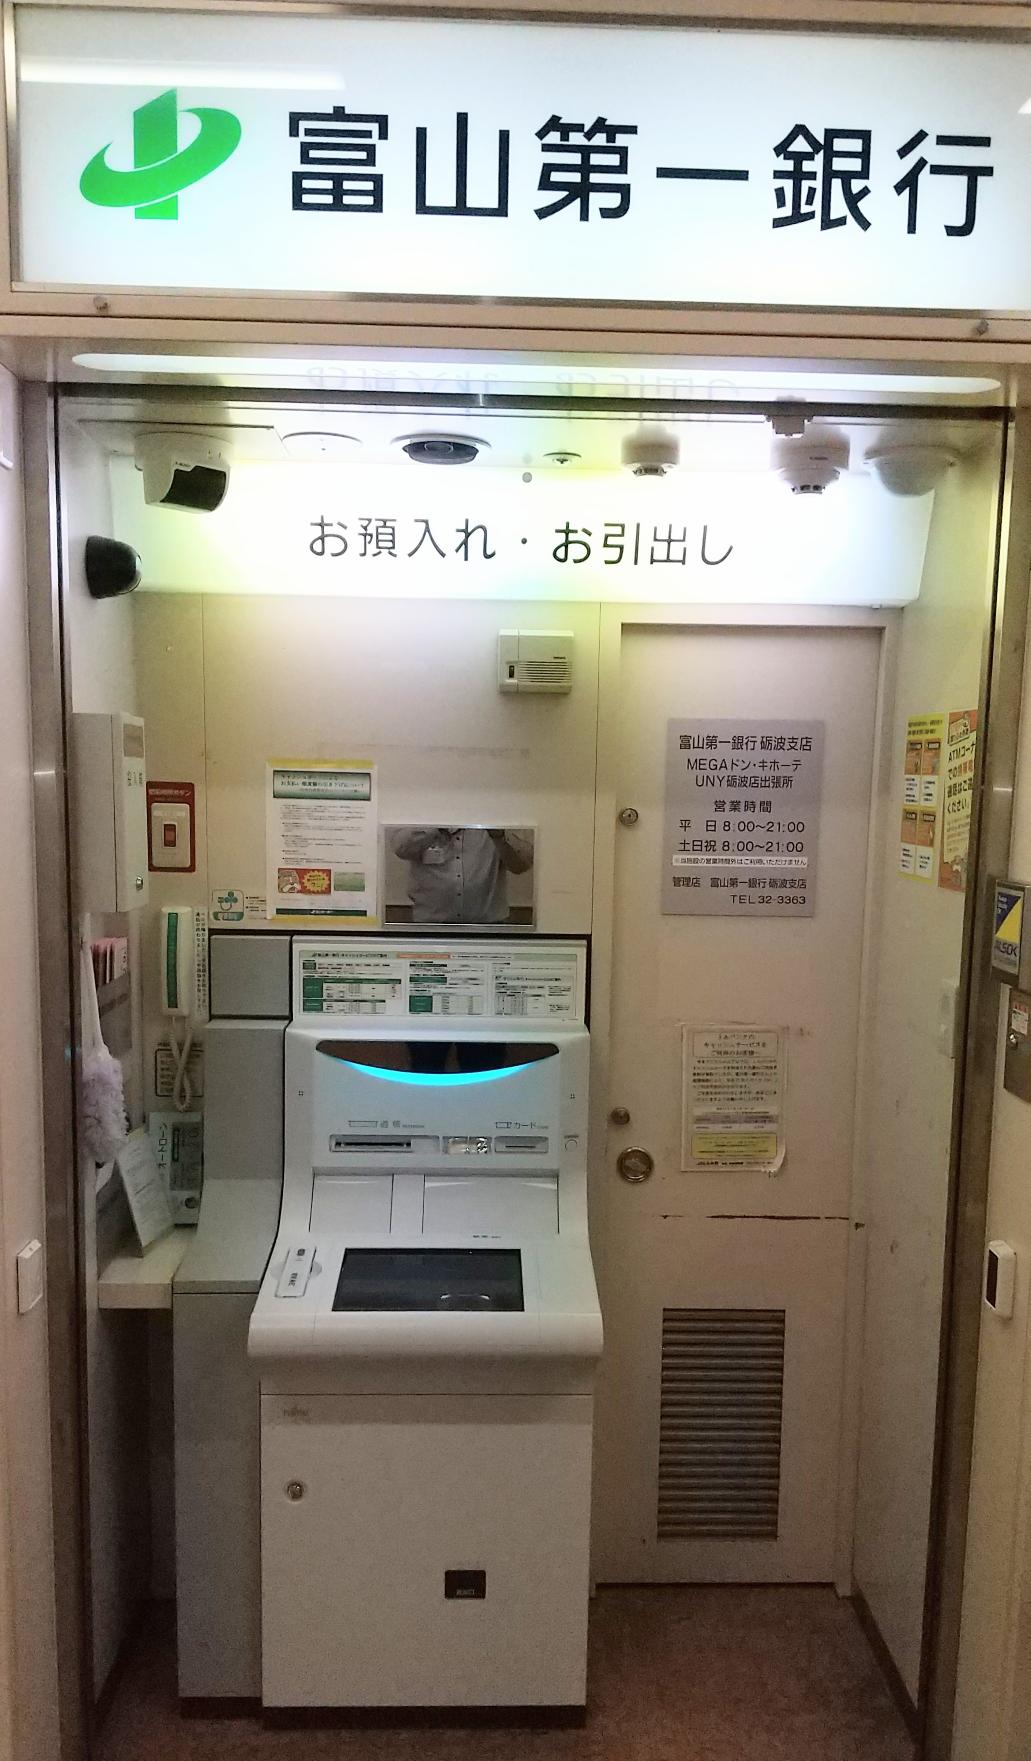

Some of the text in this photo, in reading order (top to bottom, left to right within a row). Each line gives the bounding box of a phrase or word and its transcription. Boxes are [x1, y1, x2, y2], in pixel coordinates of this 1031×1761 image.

[289, 106, 994, 236] 富山第一銀行
[714, 800, 772, 813] 営業時間
[678, 840, 717, 853] 土日祝
